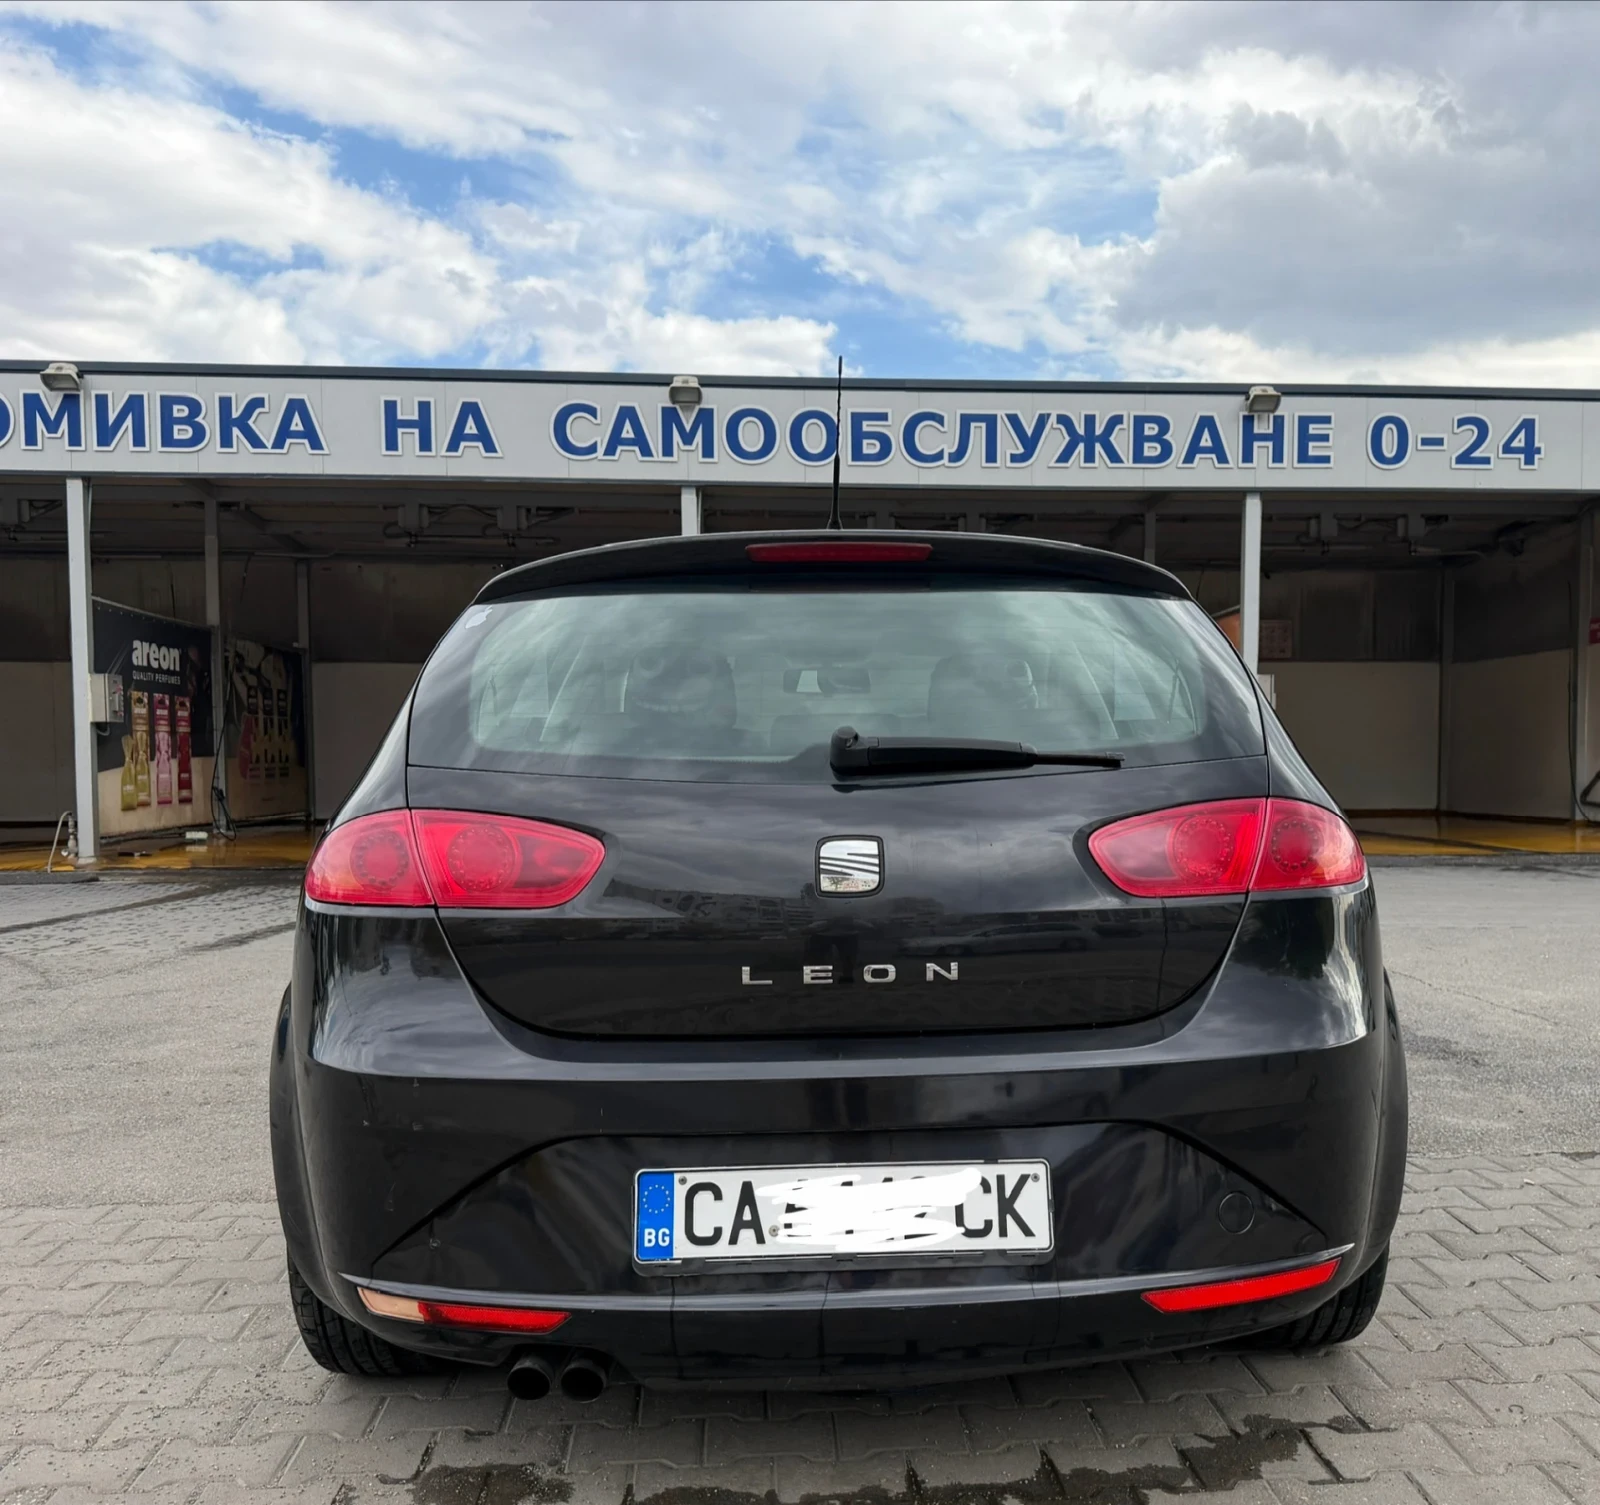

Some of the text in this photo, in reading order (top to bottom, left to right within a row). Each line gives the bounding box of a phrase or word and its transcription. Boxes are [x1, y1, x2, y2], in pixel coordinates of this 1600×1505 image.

[0, 391, 1543, 469] МИВКА НА САМООБСЛУЖВАНЕ 0-24
[132, 639, 180, 671] areon
[132, 670, 181, 685] QUALITY PERFUMES
[741, 961, 959, 985] LEON
[685, 1180, 766, 1246] CA
[644, 1228, 670, 1247] BG
